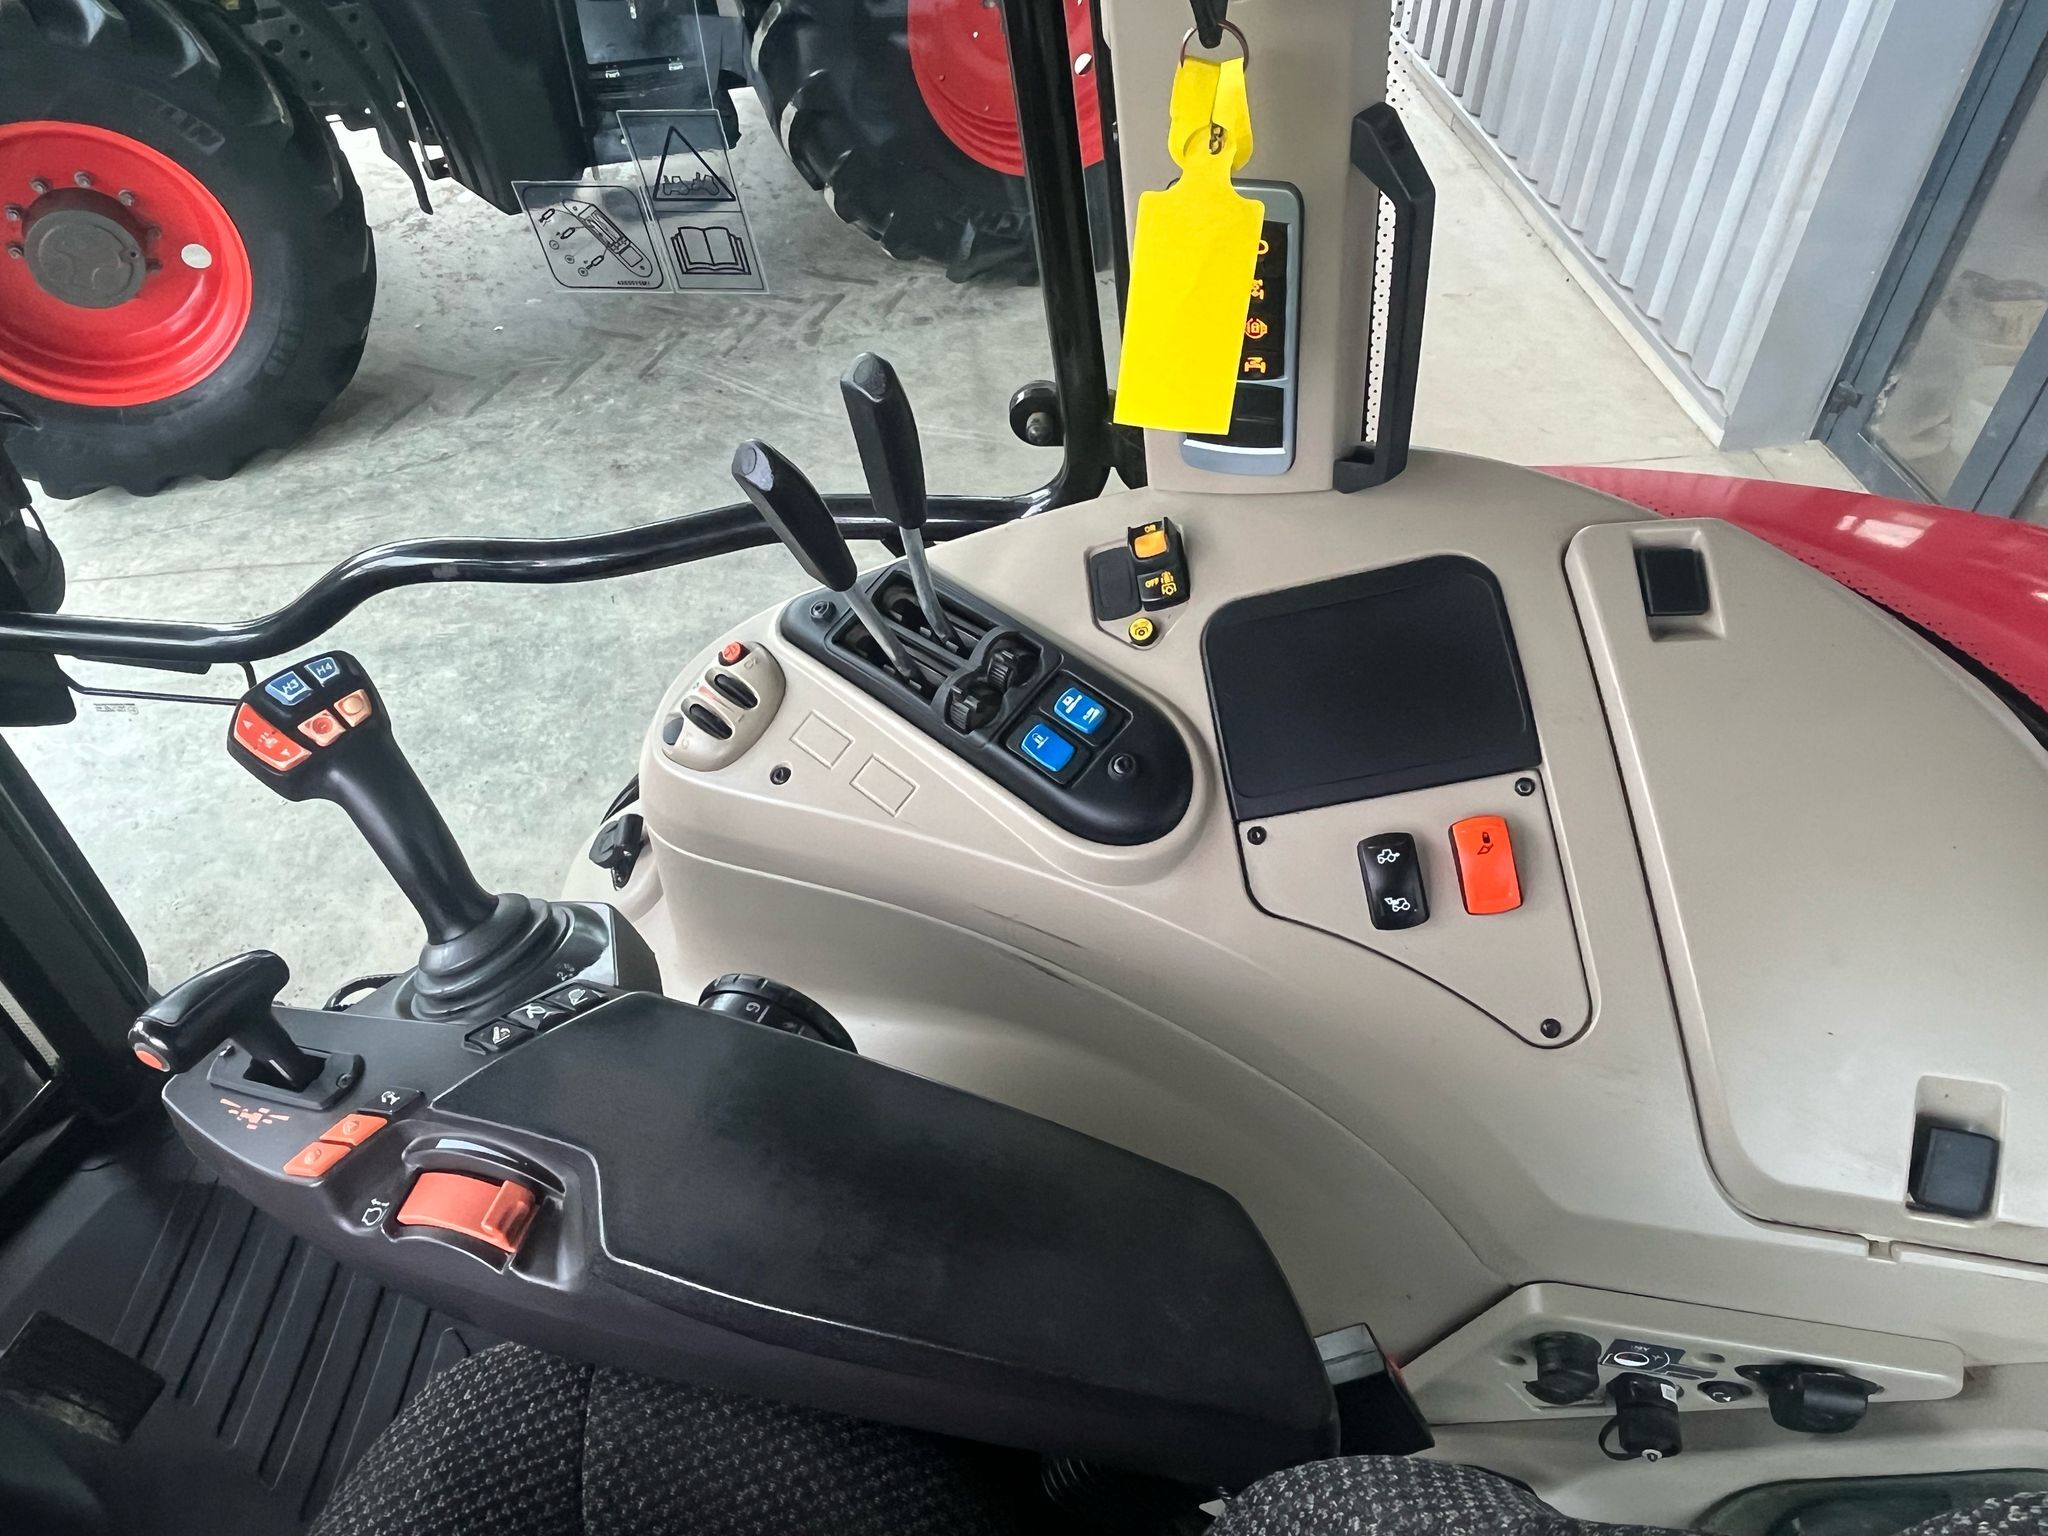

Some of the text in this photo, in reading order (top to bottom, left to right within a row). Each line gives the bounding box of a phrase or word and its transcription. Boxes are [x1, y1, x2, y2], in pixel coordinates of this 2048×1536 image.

[1144, 524, 1156, 533] ON
[1145, 577, 1159, 588] OFF
[316, 662, 333, 675] H4
[281, 678, 300, 695] H3
